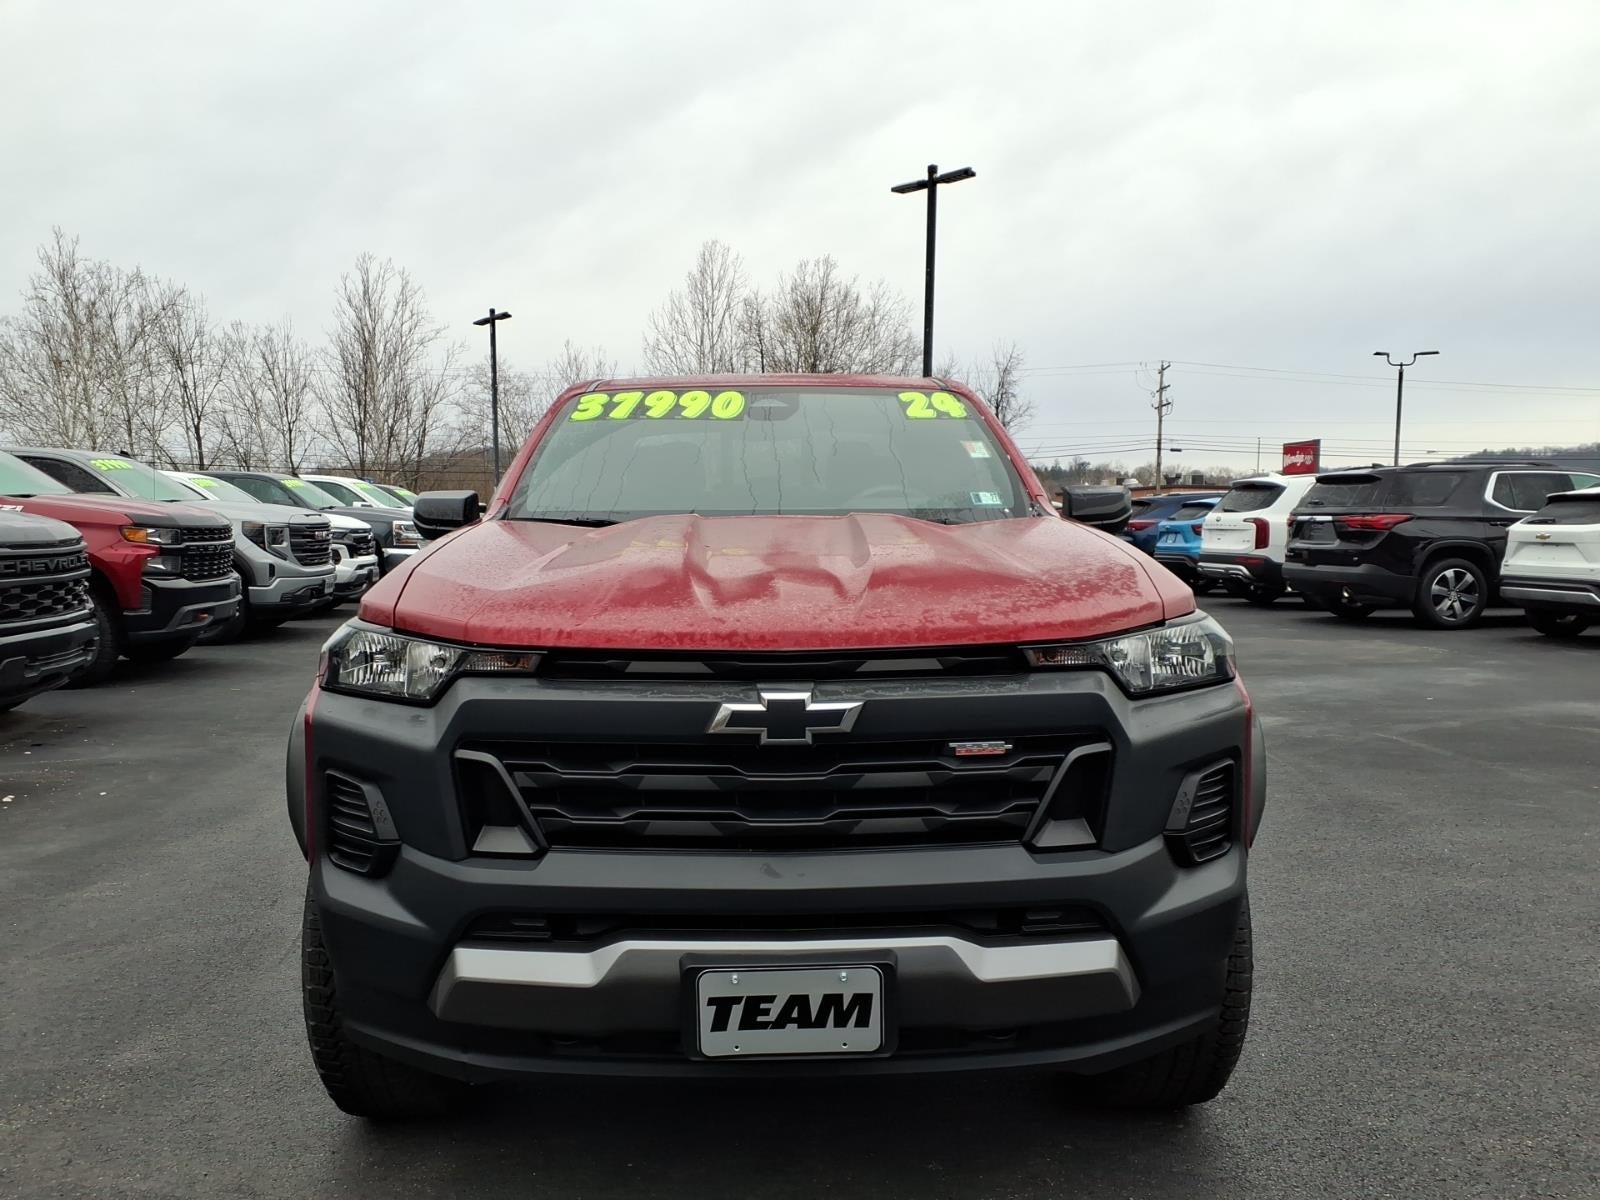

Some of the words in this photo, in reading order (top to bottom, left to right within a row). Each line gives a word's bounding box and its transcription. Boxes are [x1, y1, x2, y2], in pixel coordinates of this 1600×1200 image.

[570, 390, 745, 421] 37990
[898, 391, 967, 418] 24
[706, 993, 874, 1033] TEAM
